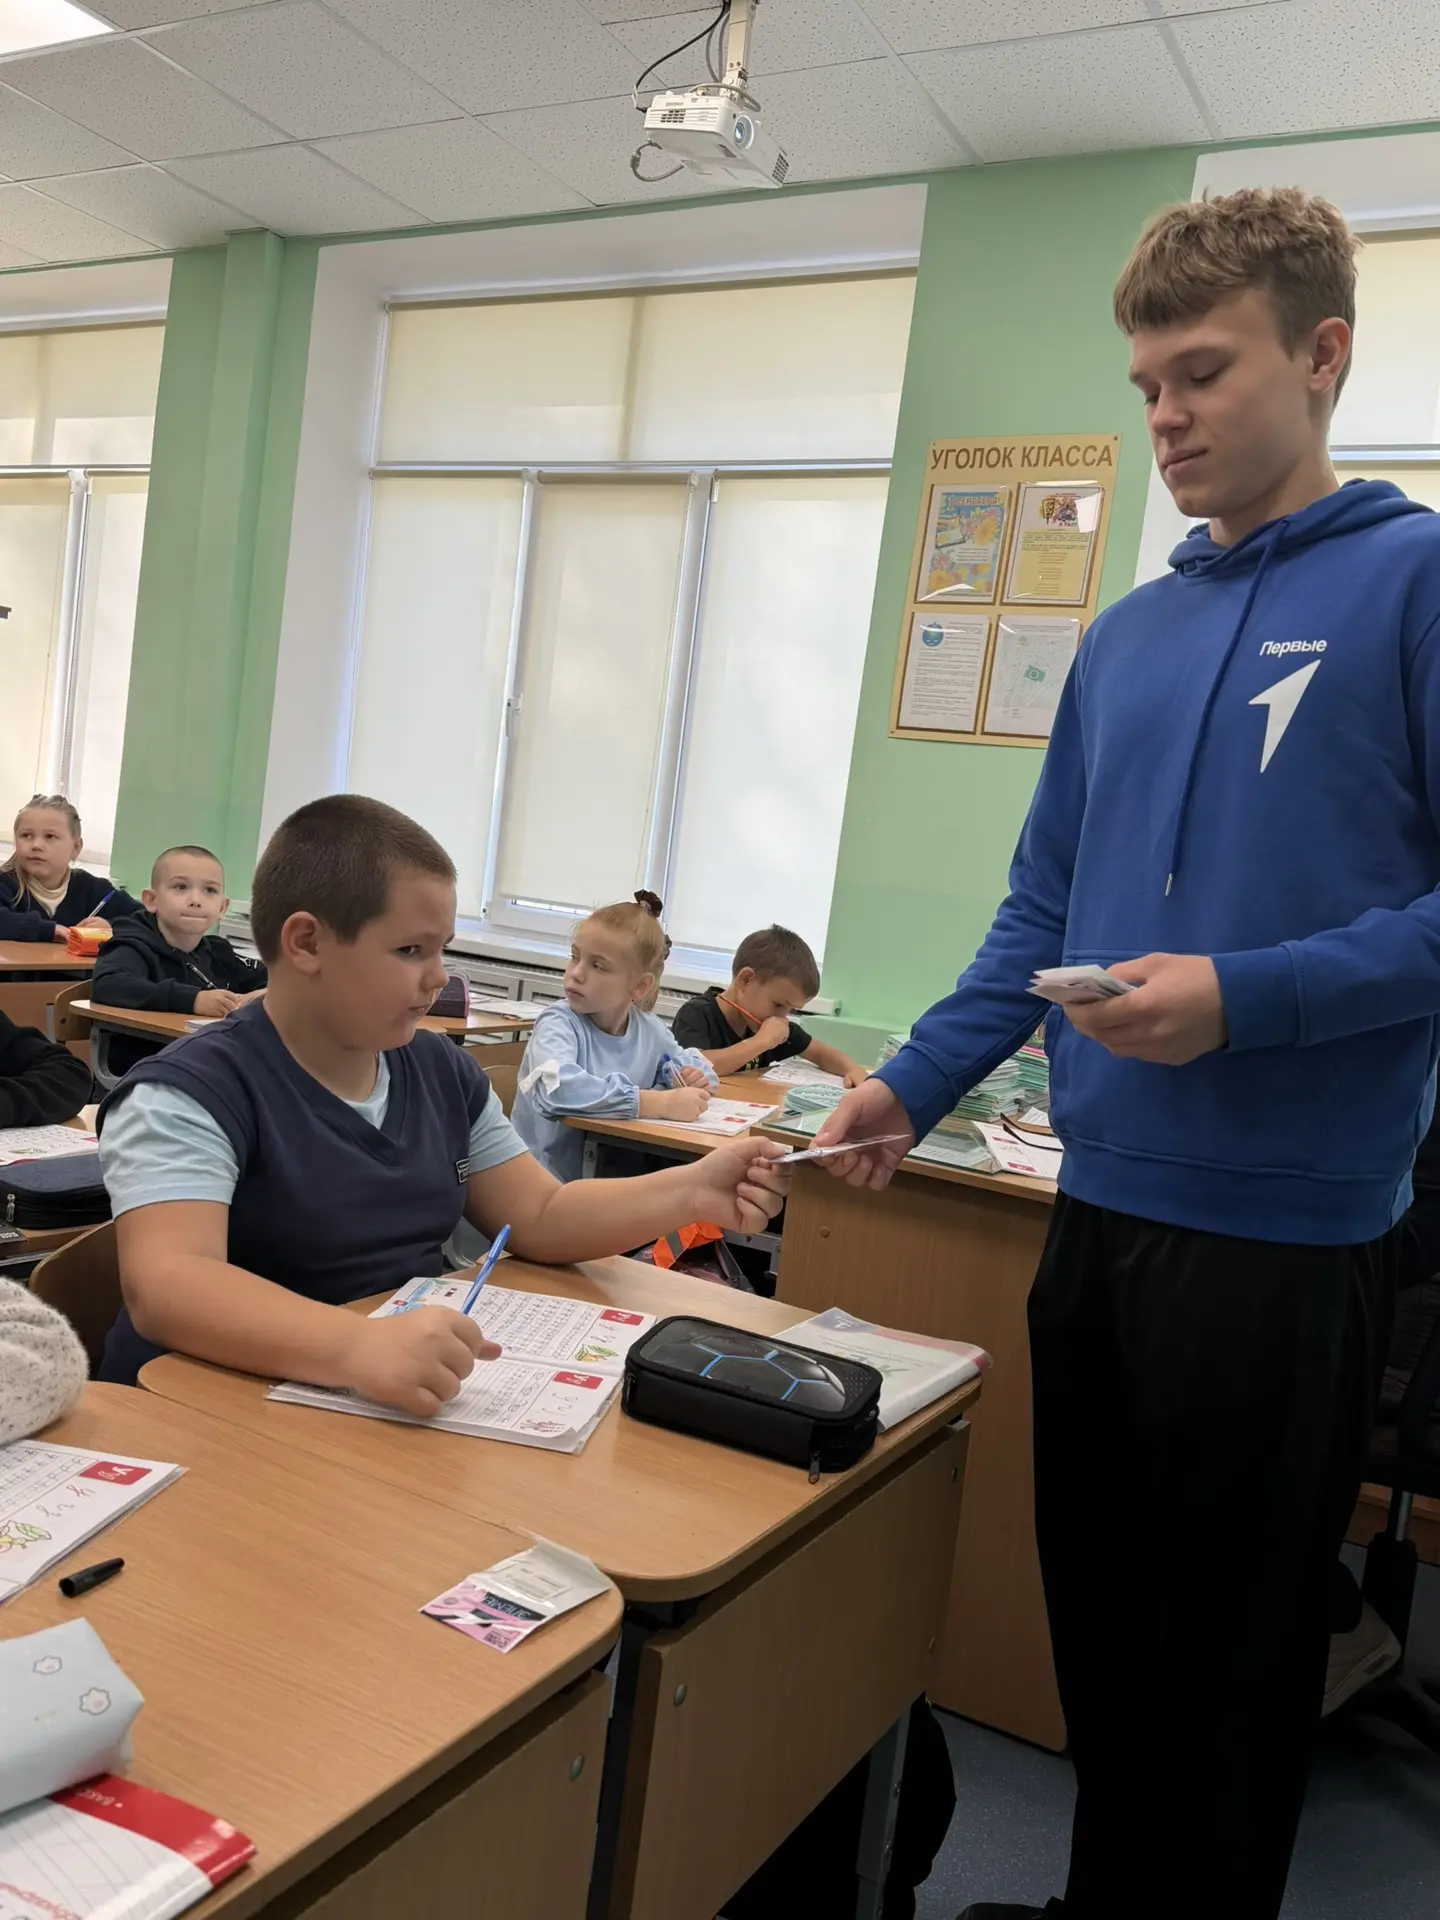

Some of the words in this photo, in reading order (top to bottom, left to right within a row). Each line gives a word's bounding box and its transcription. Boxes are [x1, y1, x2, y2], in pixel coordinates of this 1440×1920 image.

[931, 447, 1015, 469] УГОЛОК
[1020, 445, 1113, 467] КЛАССА
[1259, 639, 1327, 658] Первые
